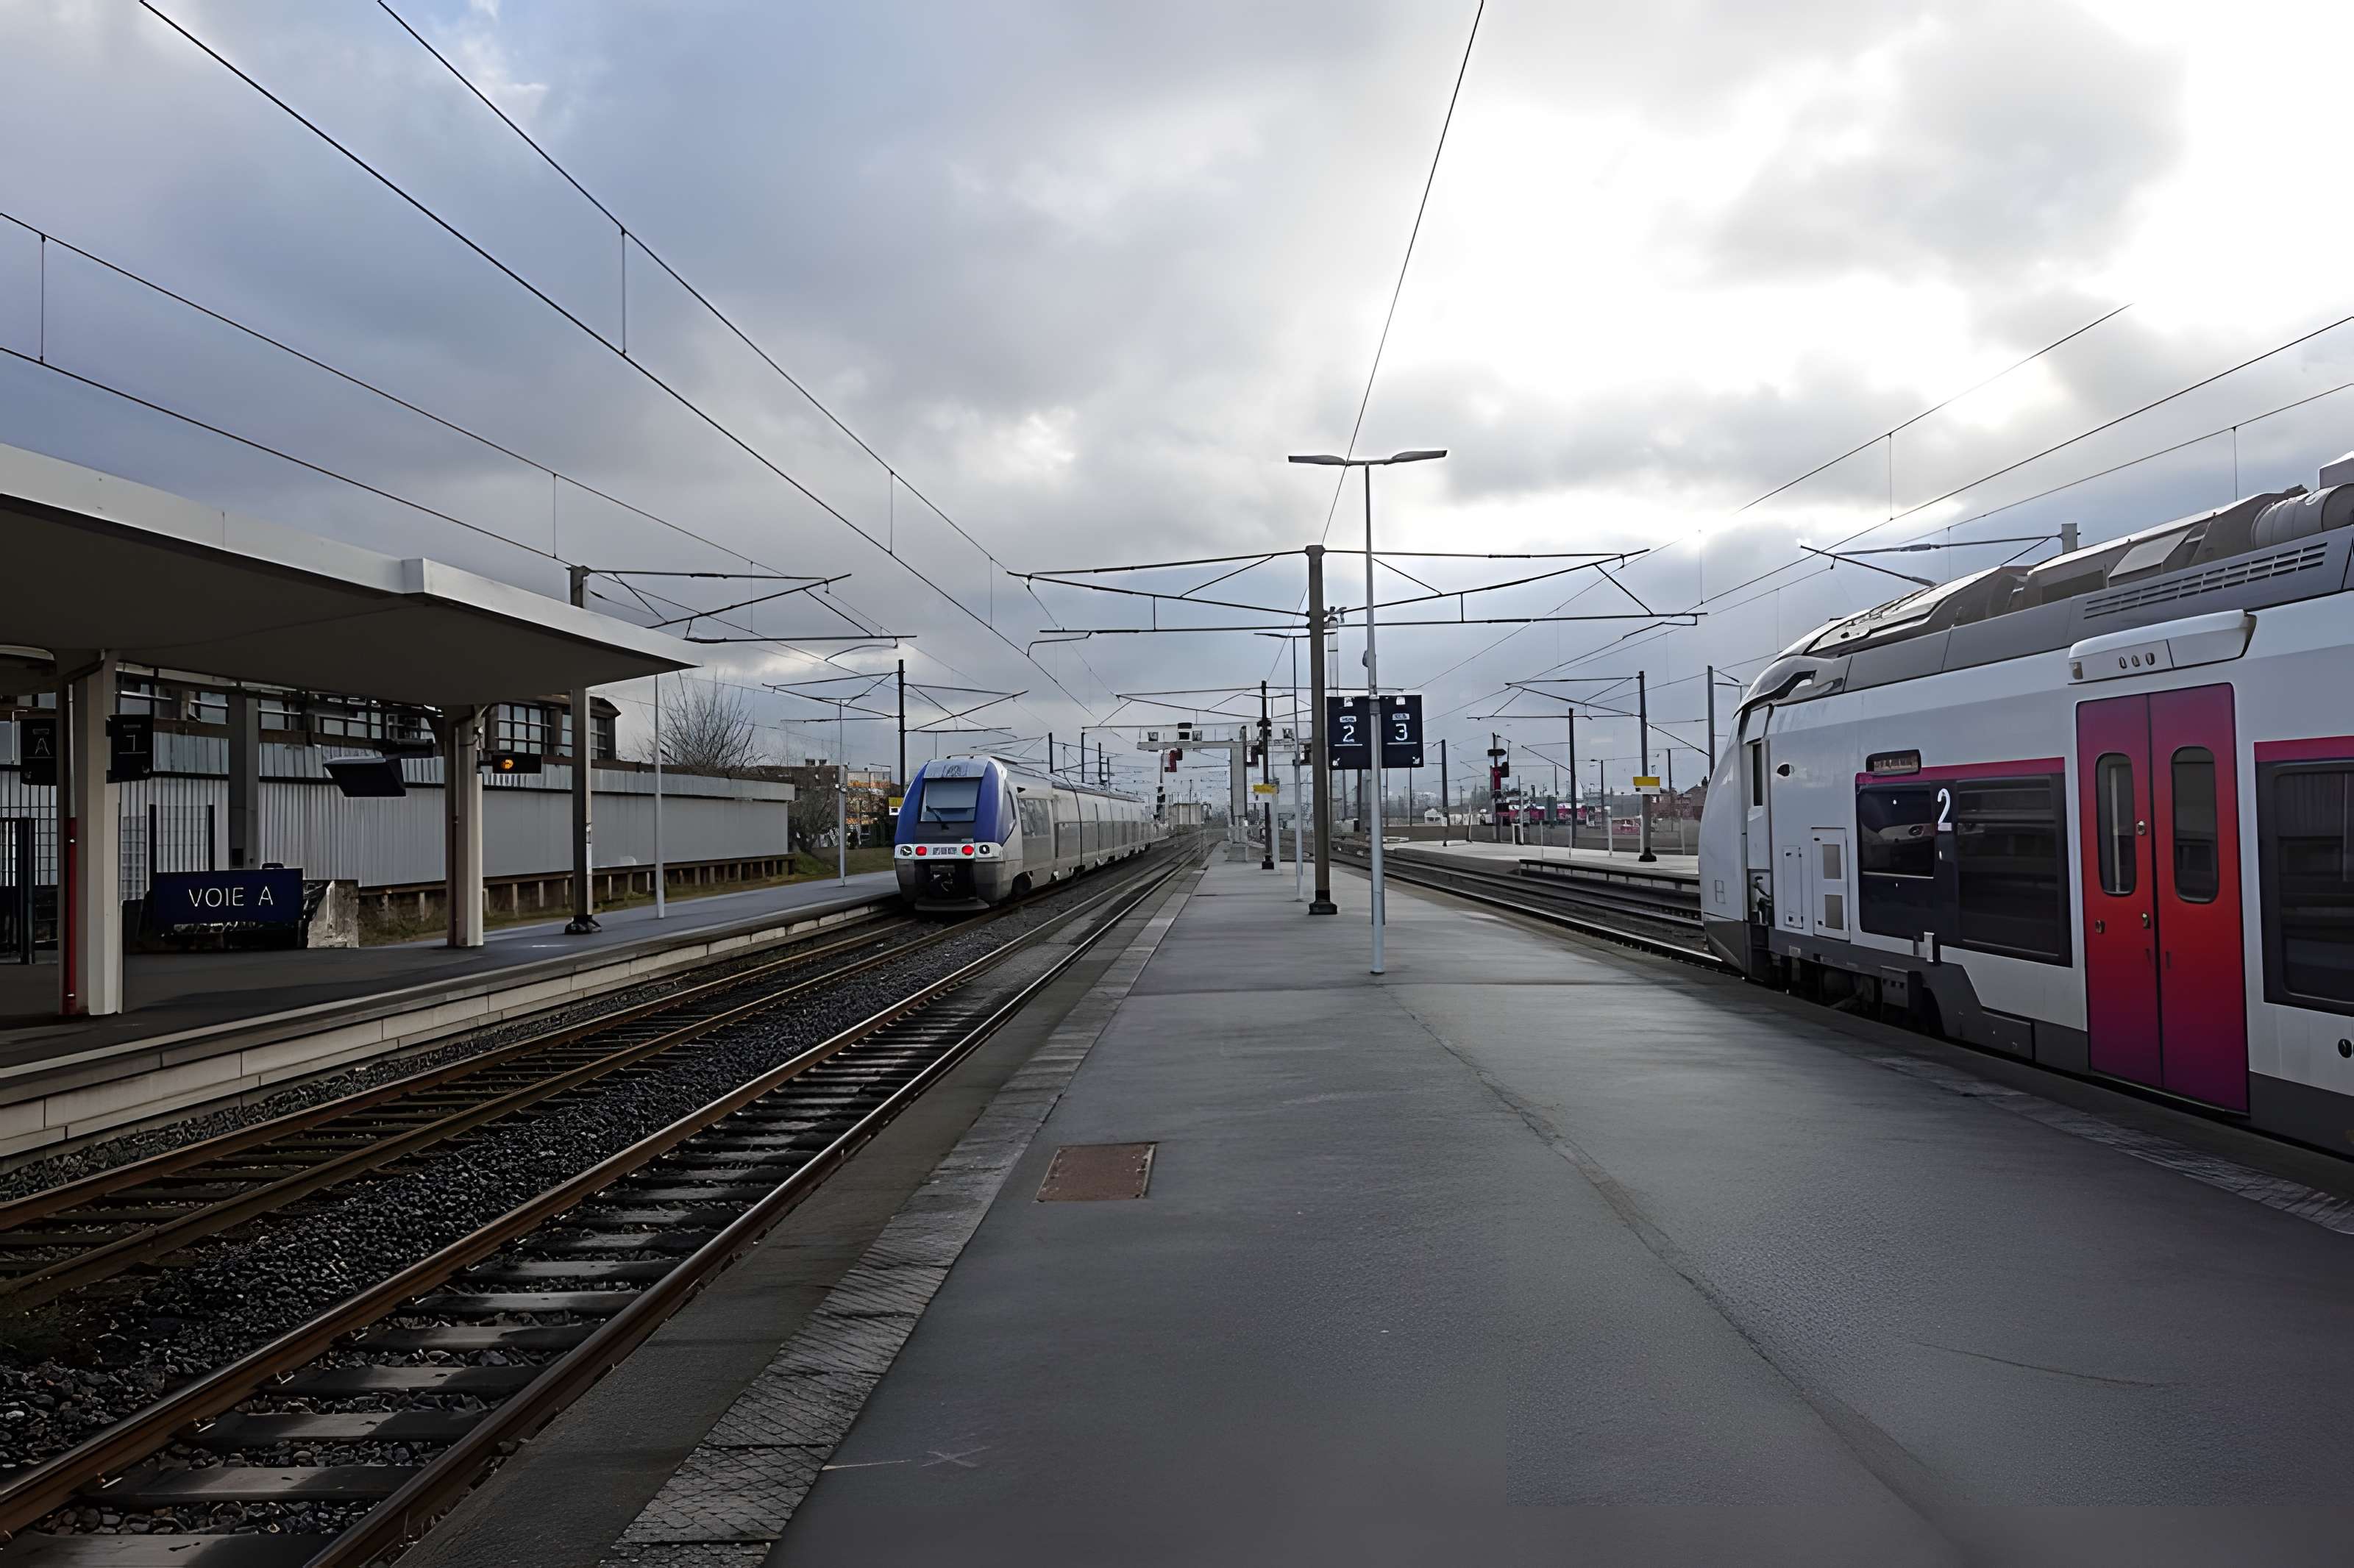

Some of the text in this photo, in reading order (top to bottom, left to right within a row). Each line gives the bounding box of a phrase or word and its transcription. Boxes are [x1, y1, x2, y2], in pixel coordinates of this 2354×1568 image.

[1343, 725, 1355, 742] 2
[1395, 723, 1408, 741] 3
[1937, 788, 1952, 831] 2
[188, 885, 274, 908] VOIE A
